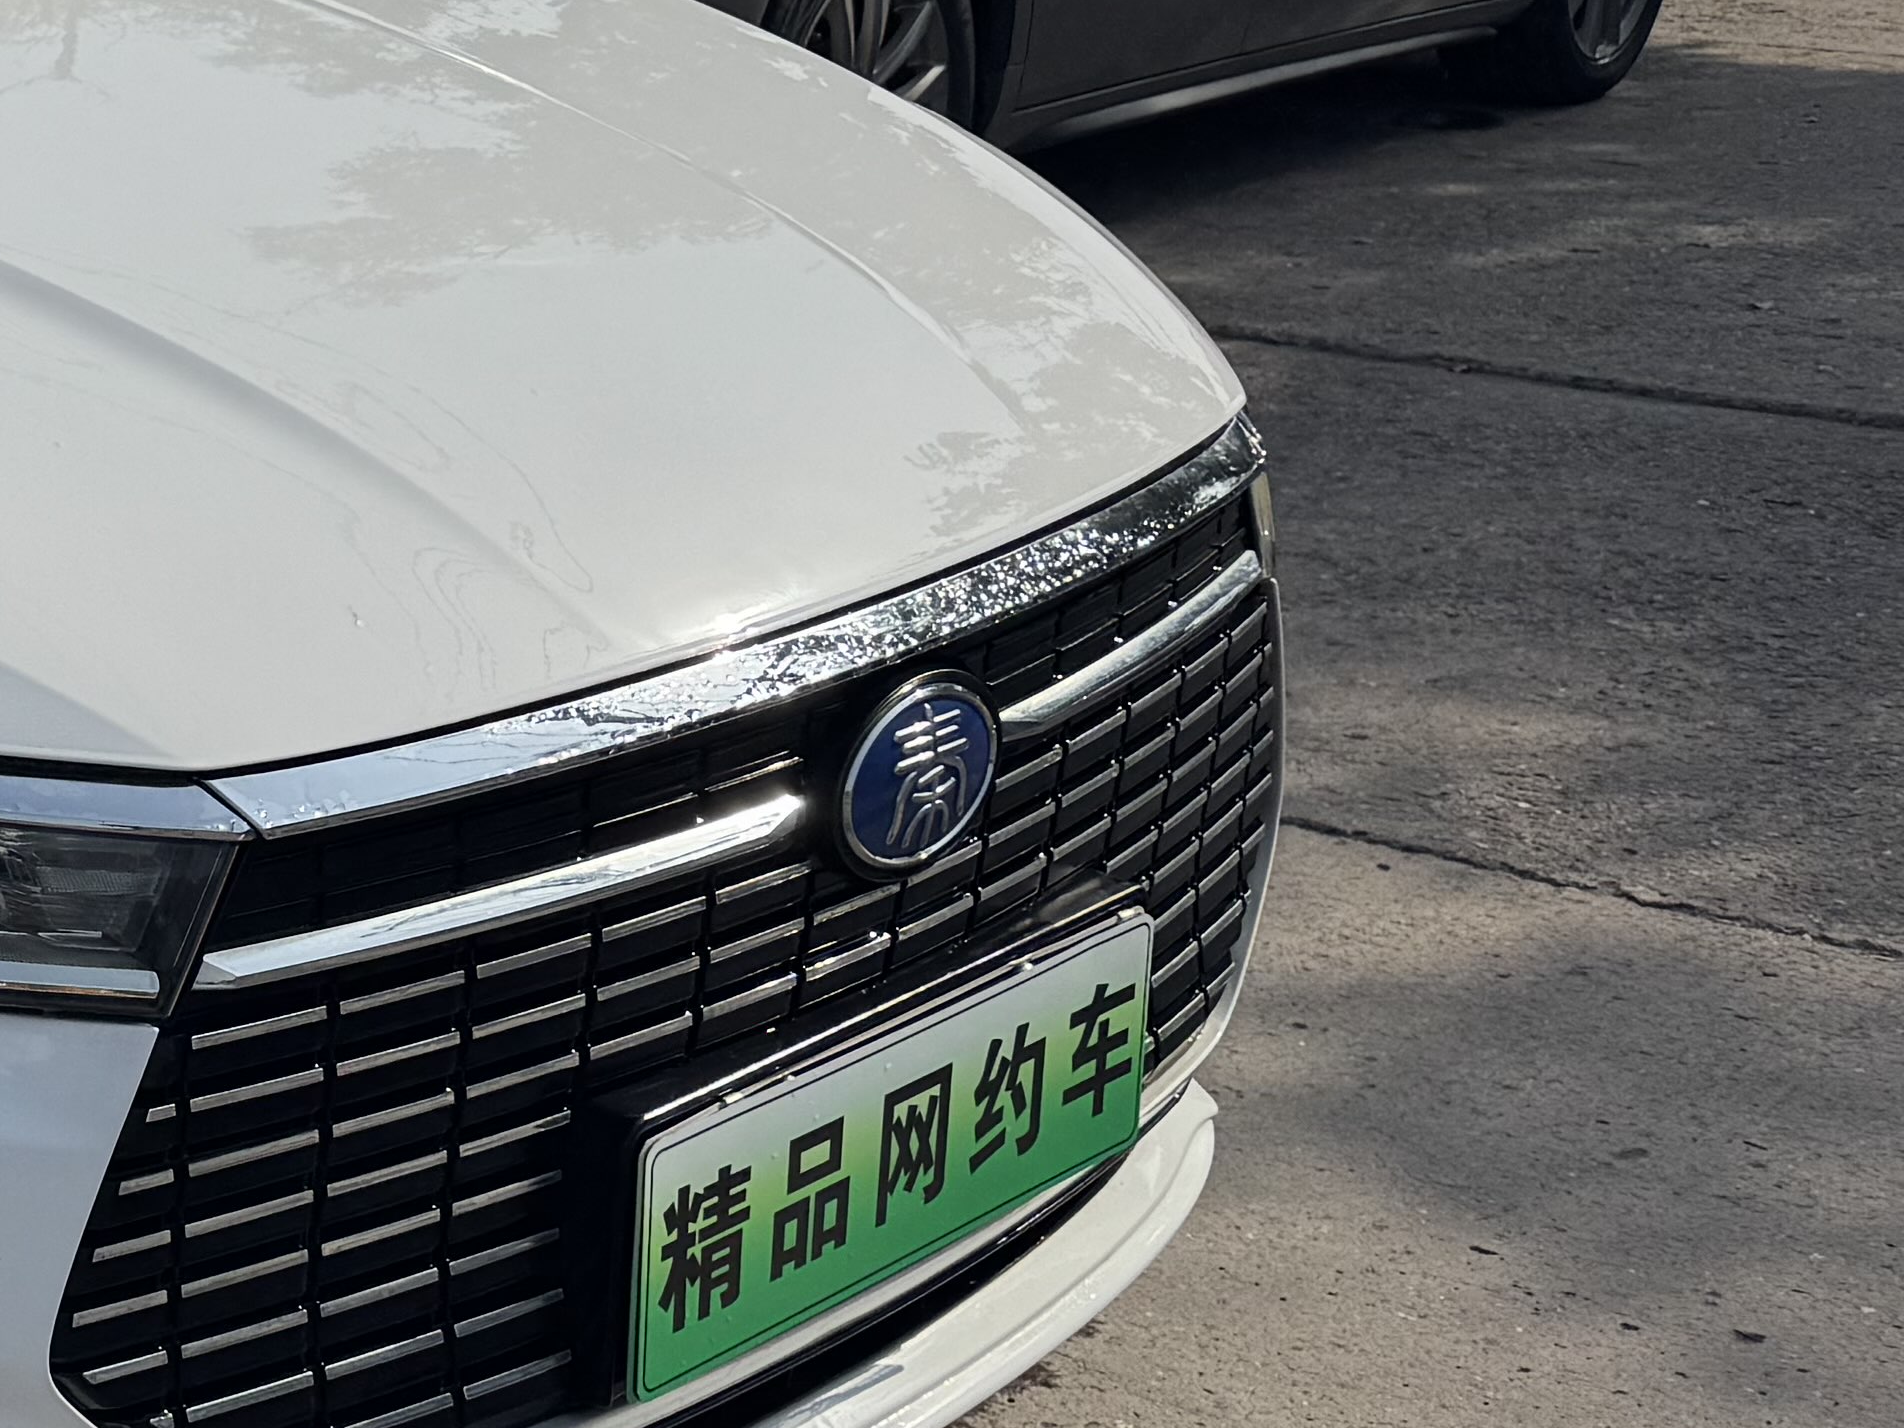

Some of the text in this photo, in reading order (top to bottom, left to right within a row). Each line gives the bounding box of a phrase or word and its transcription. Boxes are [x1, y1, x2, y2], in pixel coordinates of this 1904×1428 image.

[656, 982, 1138, 1335] 精品网约车
